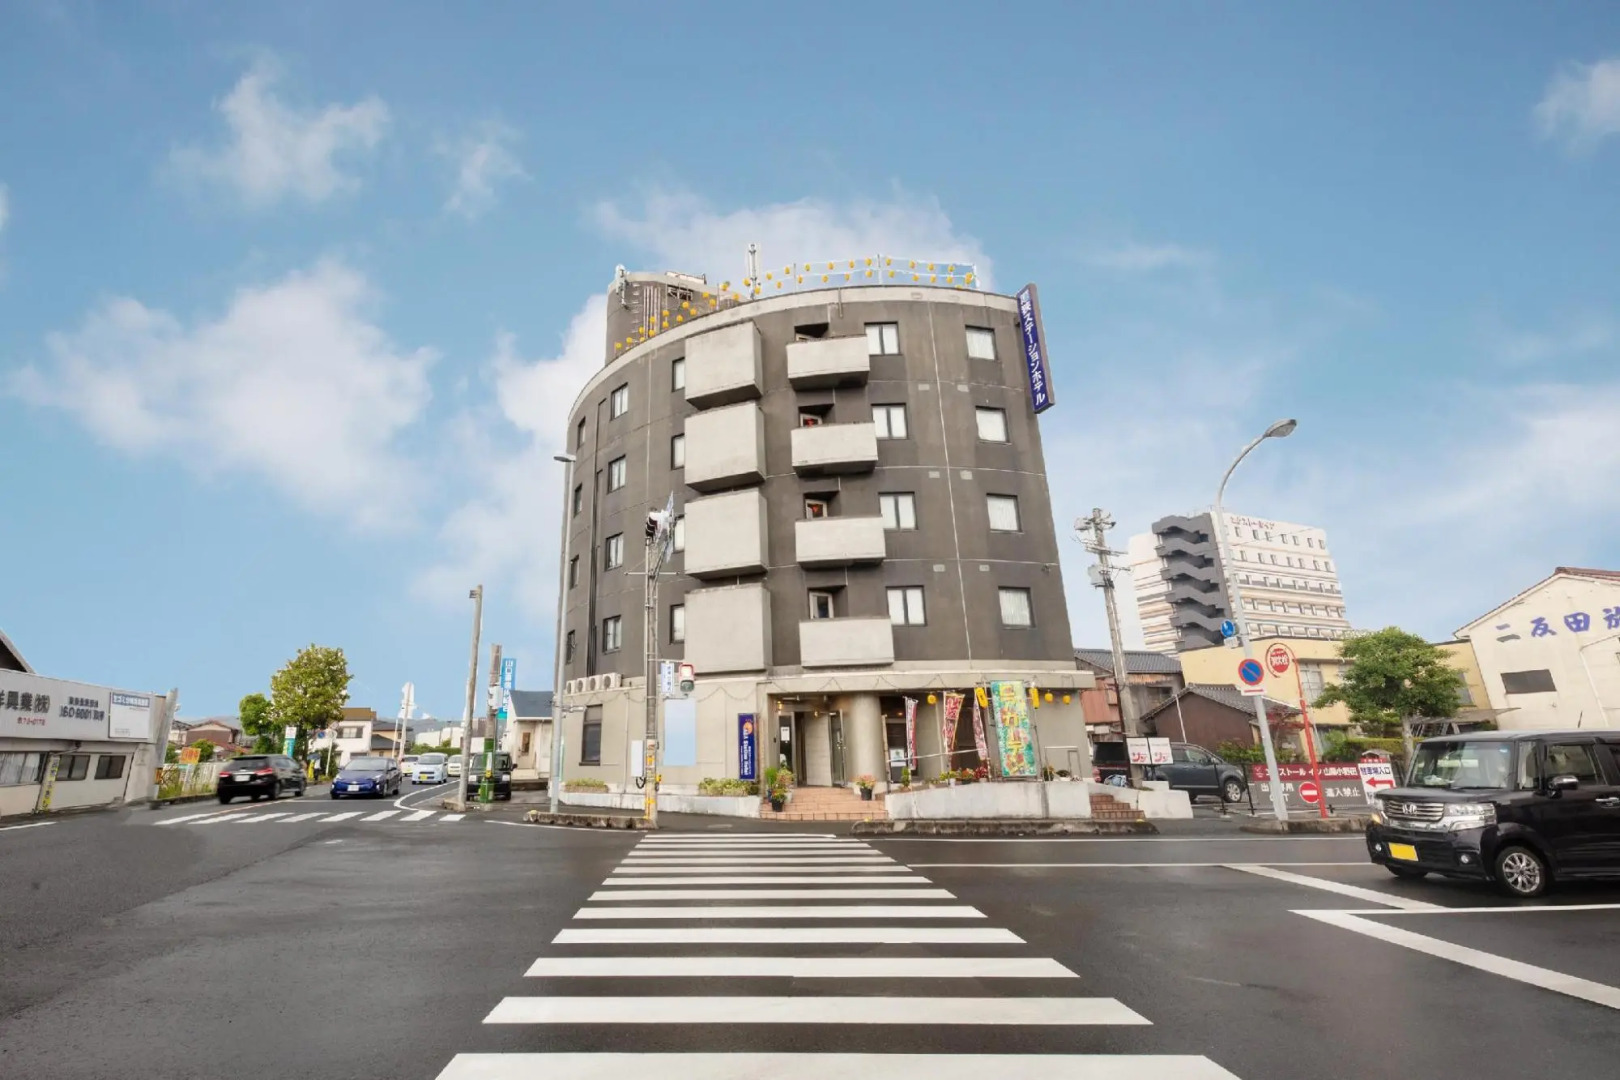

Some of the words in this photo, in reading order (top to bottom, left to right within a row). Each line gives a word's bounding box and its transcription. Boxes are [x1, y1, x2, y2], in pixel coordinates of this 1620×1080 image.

[1265, 767, 1307, 777] エストール
[1261, 782, 1294, 792] 出用
[1269, 793, 1290, 803] OT
